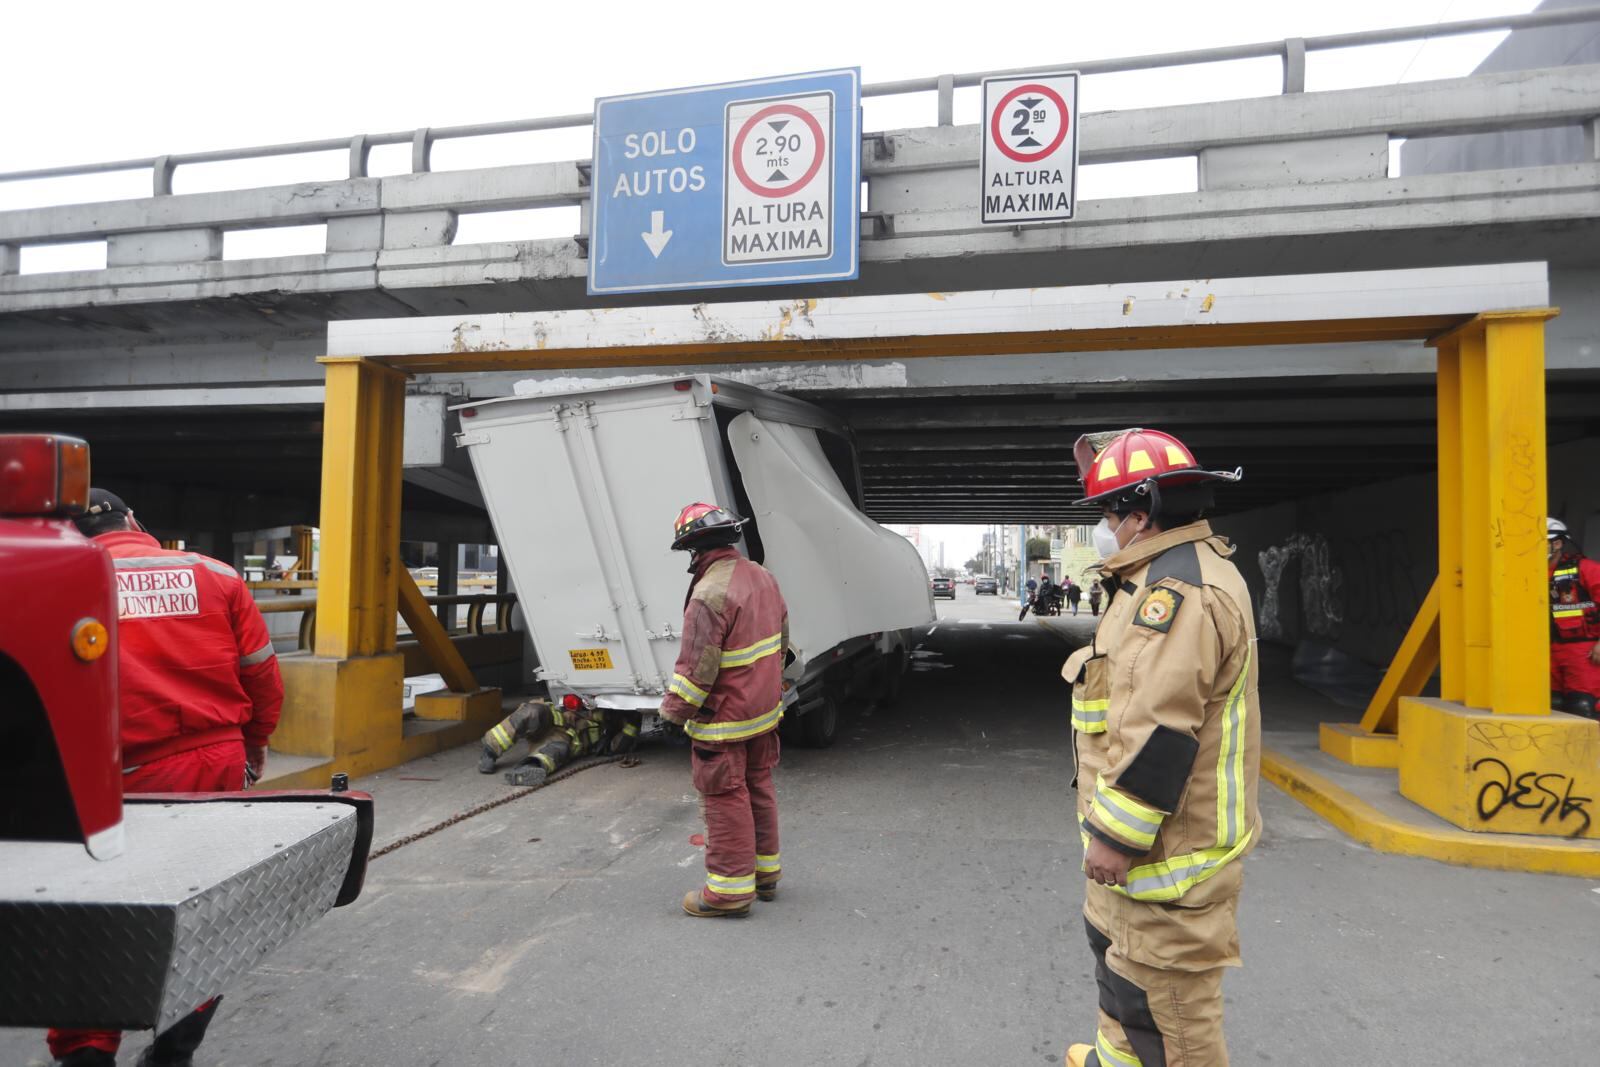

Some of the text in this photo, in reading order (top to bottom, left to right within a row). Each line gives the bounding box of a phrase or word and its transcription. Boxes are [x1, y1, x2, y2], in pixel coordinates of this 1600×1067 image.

[624, 127, 696, 159] SOLO
[766, 156, 789, 168] mts
[613, 165, 706, 198] AUTOS
[991, 169, 1063, 187] ALTURA
[731, 200, 824, 227] ALTURA
[986, 192, 1069, 214] MAXIMA
[730, 228, 822, 254] MAXIMA
